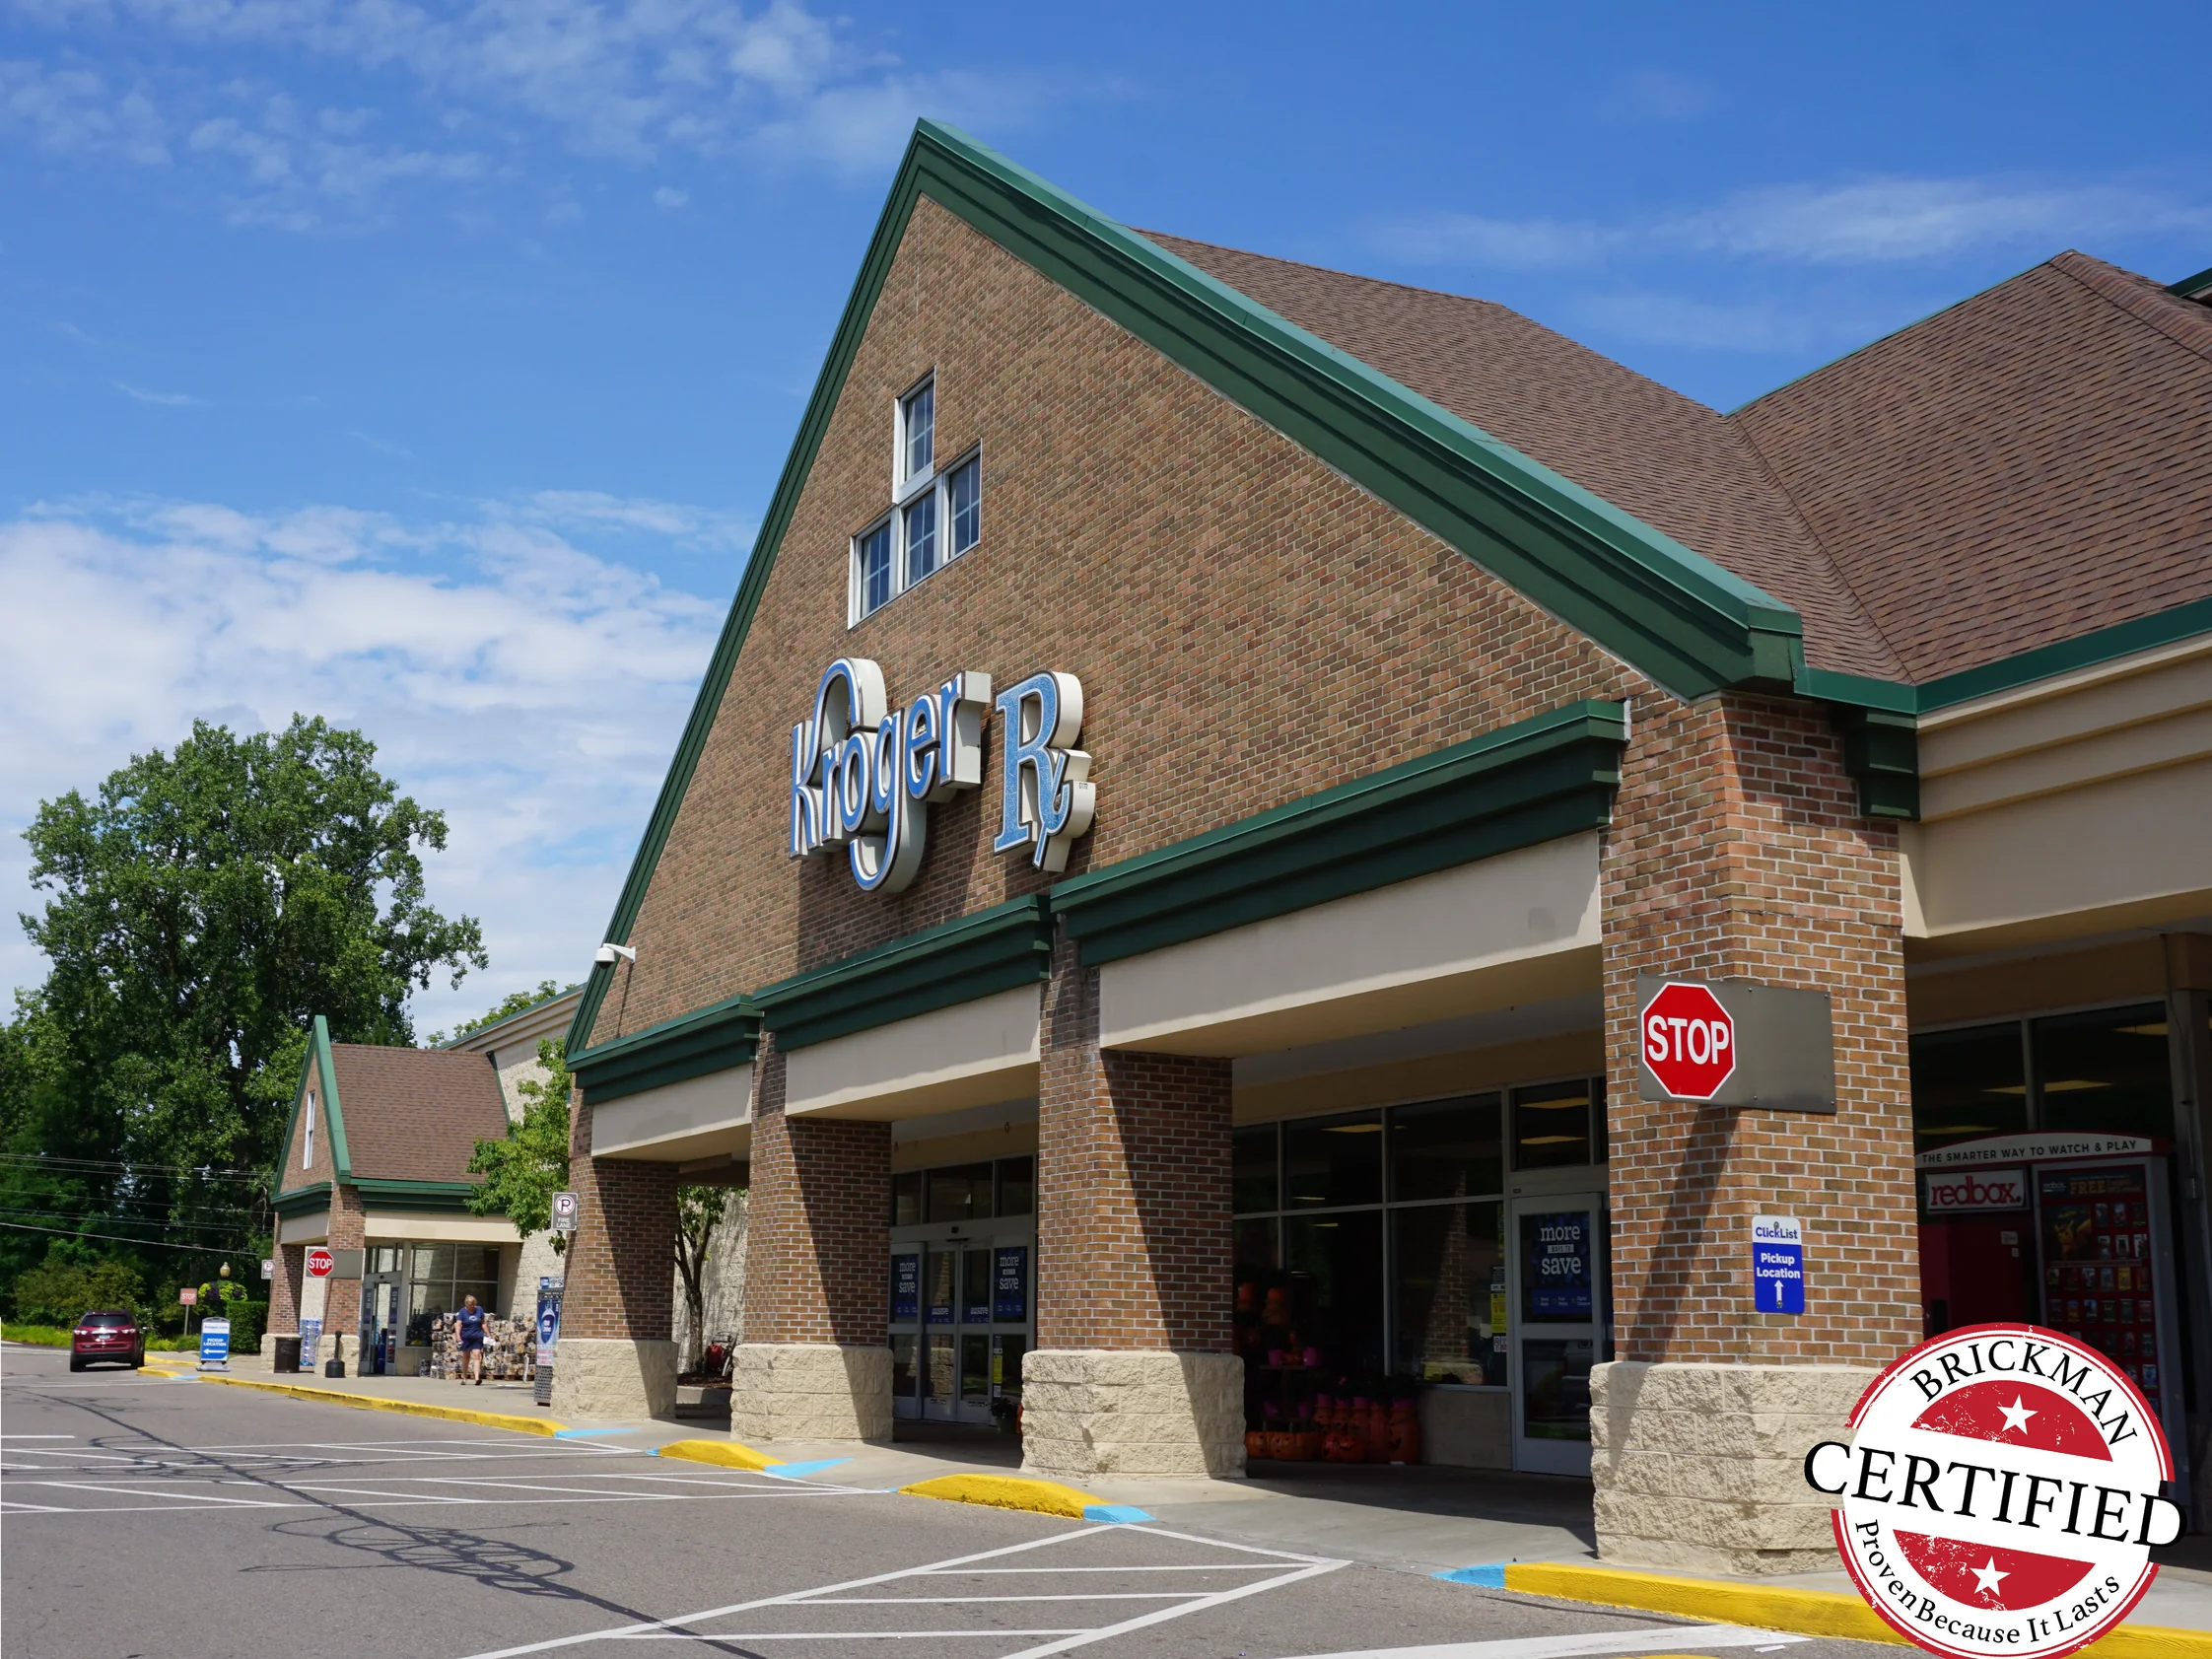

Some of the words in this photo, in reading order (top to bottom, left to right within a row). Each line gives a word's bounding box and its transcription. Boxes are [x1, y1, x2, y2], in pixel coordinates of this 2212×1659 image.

[790, 657, 986, 892] Kroger
[1647, 1014, 1730, 1065] STOP
[1922, 1153, 1942, 1163] THE
[1947, 1149, 1997, 1162] SMARTER
[2001, 1147, 2026, 1158] WAY
[2031, 1146, 2044, 1156] TO
[2048, 1143, 2090, 1154] WATCH
[2095, 1142, 2102, 1151] &
[2108, 1141, 2137, 1151] PLAY
[2069, 1180, 2107, 1195] FREE
[1540, 1225, 1581, 1242] more
[1755, 1225, 1798, 1240] ClickList
[309, 1258, 332, 1270] STOP
[1000, 1255, 1019, 1267] more
[1541, 1256, 1582, 1275] save
[1761, 1252, 1795, 1266] Pickup
[899, 1262, 916, 1272] more
[1756, 1267, 1801, 1279] Location
[898, 1281, 916, 1293] save
[999, 1277, 1019, 1290] save
